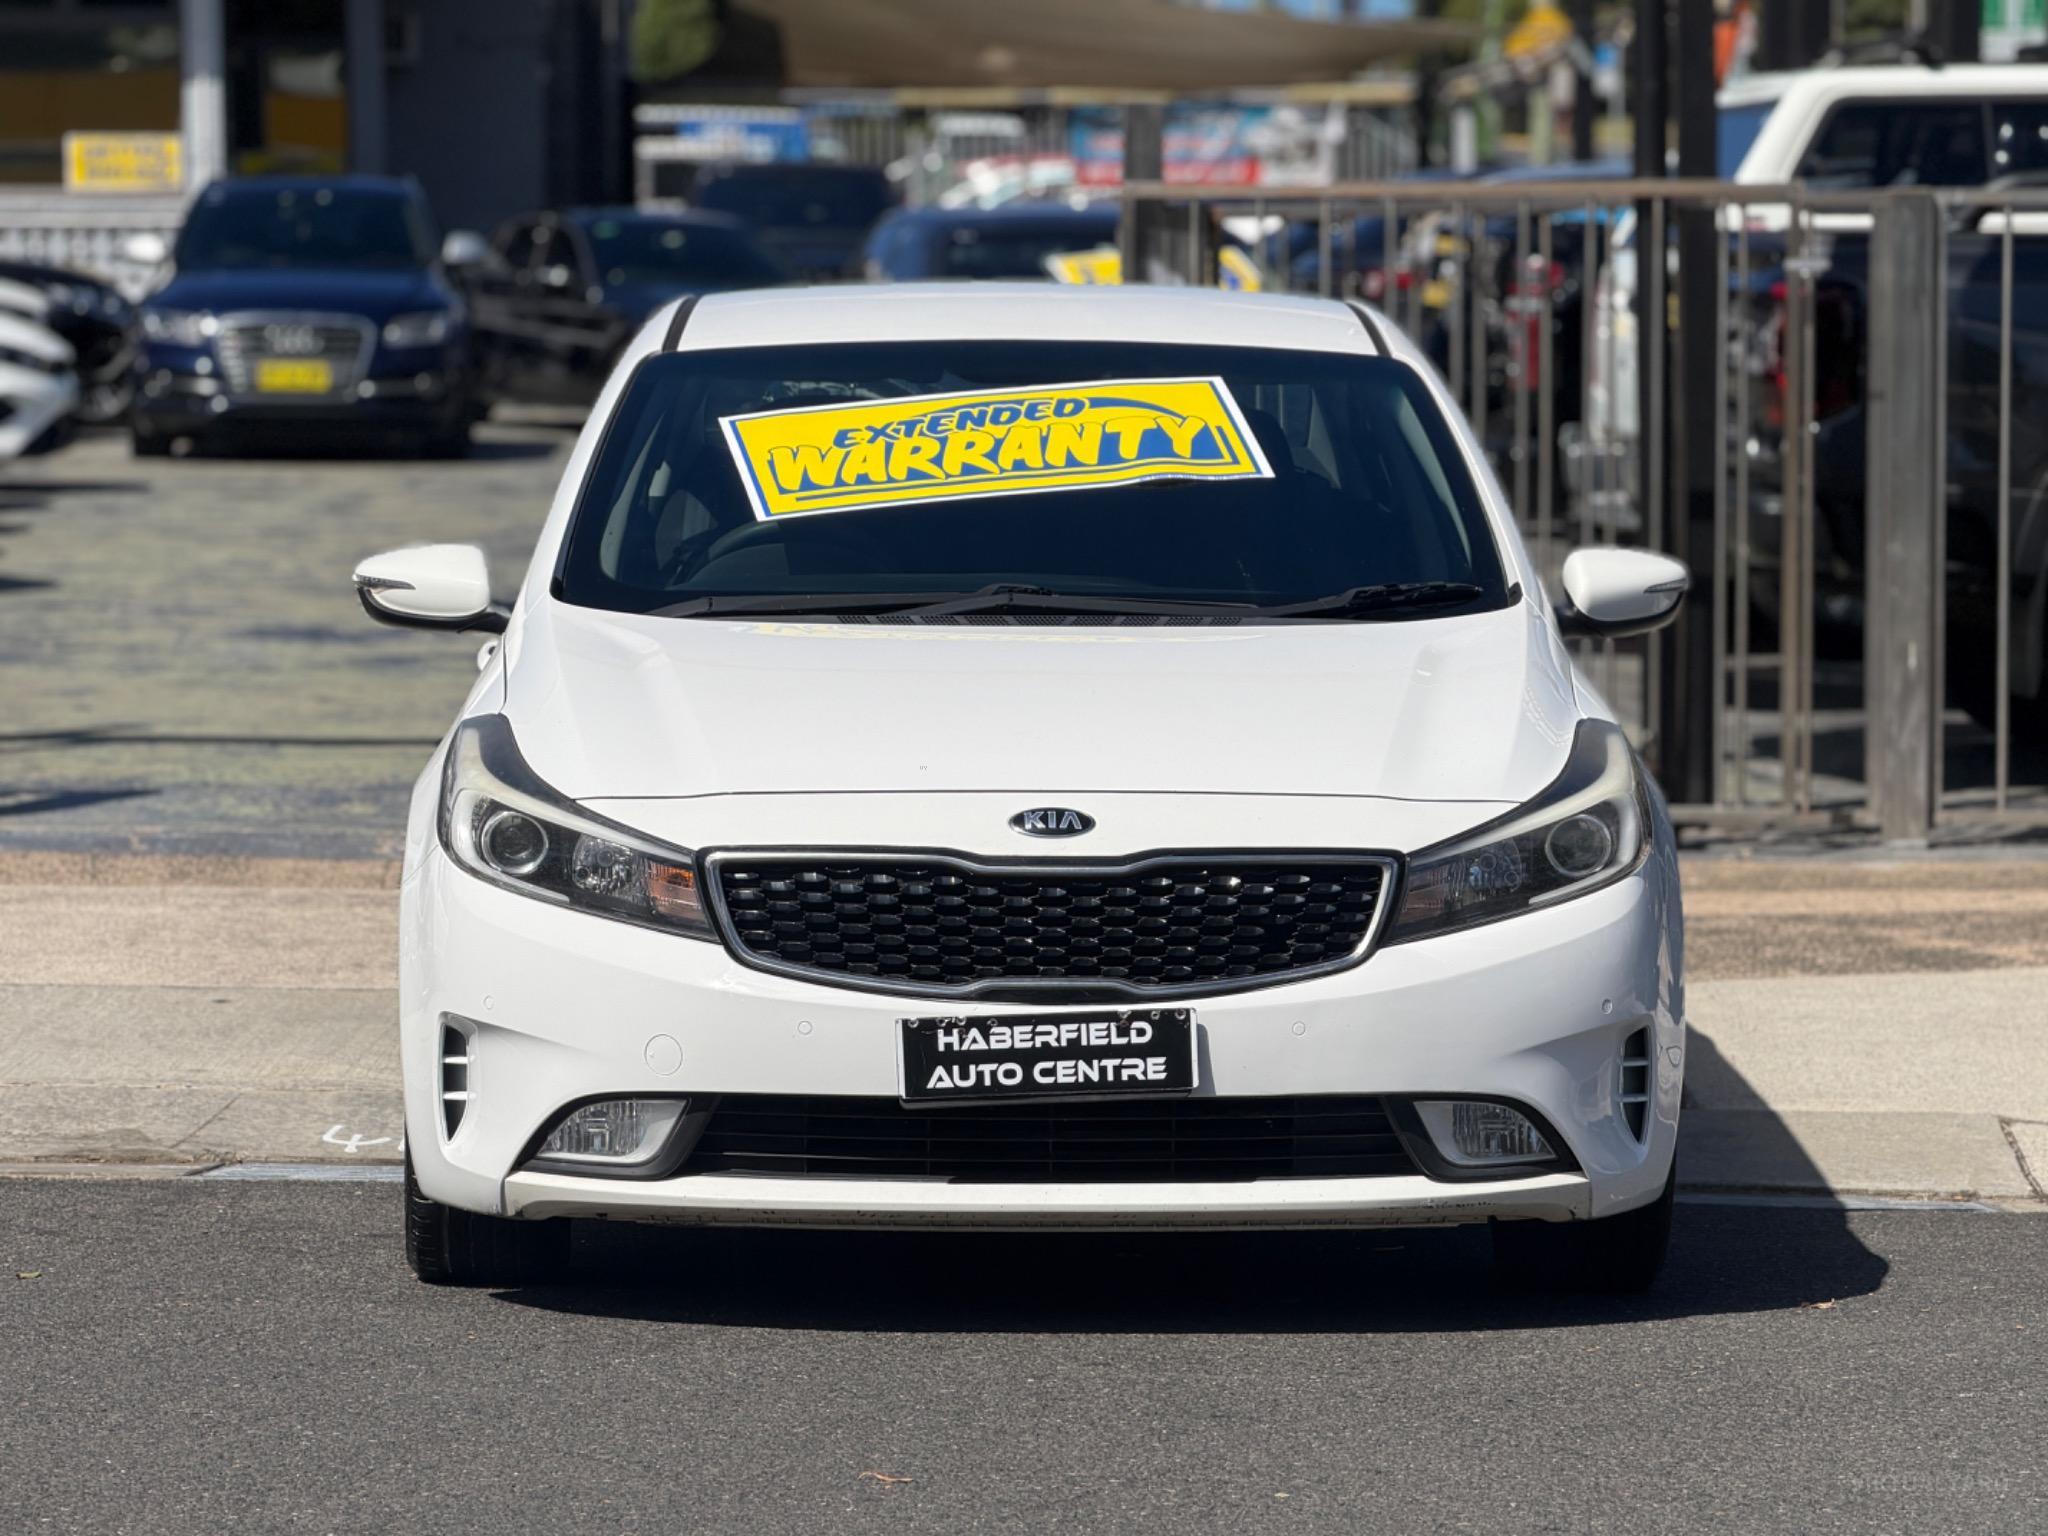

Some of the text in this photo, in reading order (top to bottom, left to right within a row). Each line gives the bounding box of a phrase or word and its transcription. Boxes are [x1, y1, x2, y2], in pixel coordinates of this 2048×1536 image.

[833, 397, 1090, 449] EXTENDED
[768, 415, 1208, 491] WARRANTY
[1023, 811, 1082, 829] KIA
[937, 1021, 1153, 1052] HABERFIELD
[926, 1056, 1168, 1089] AUTO CENTRE
